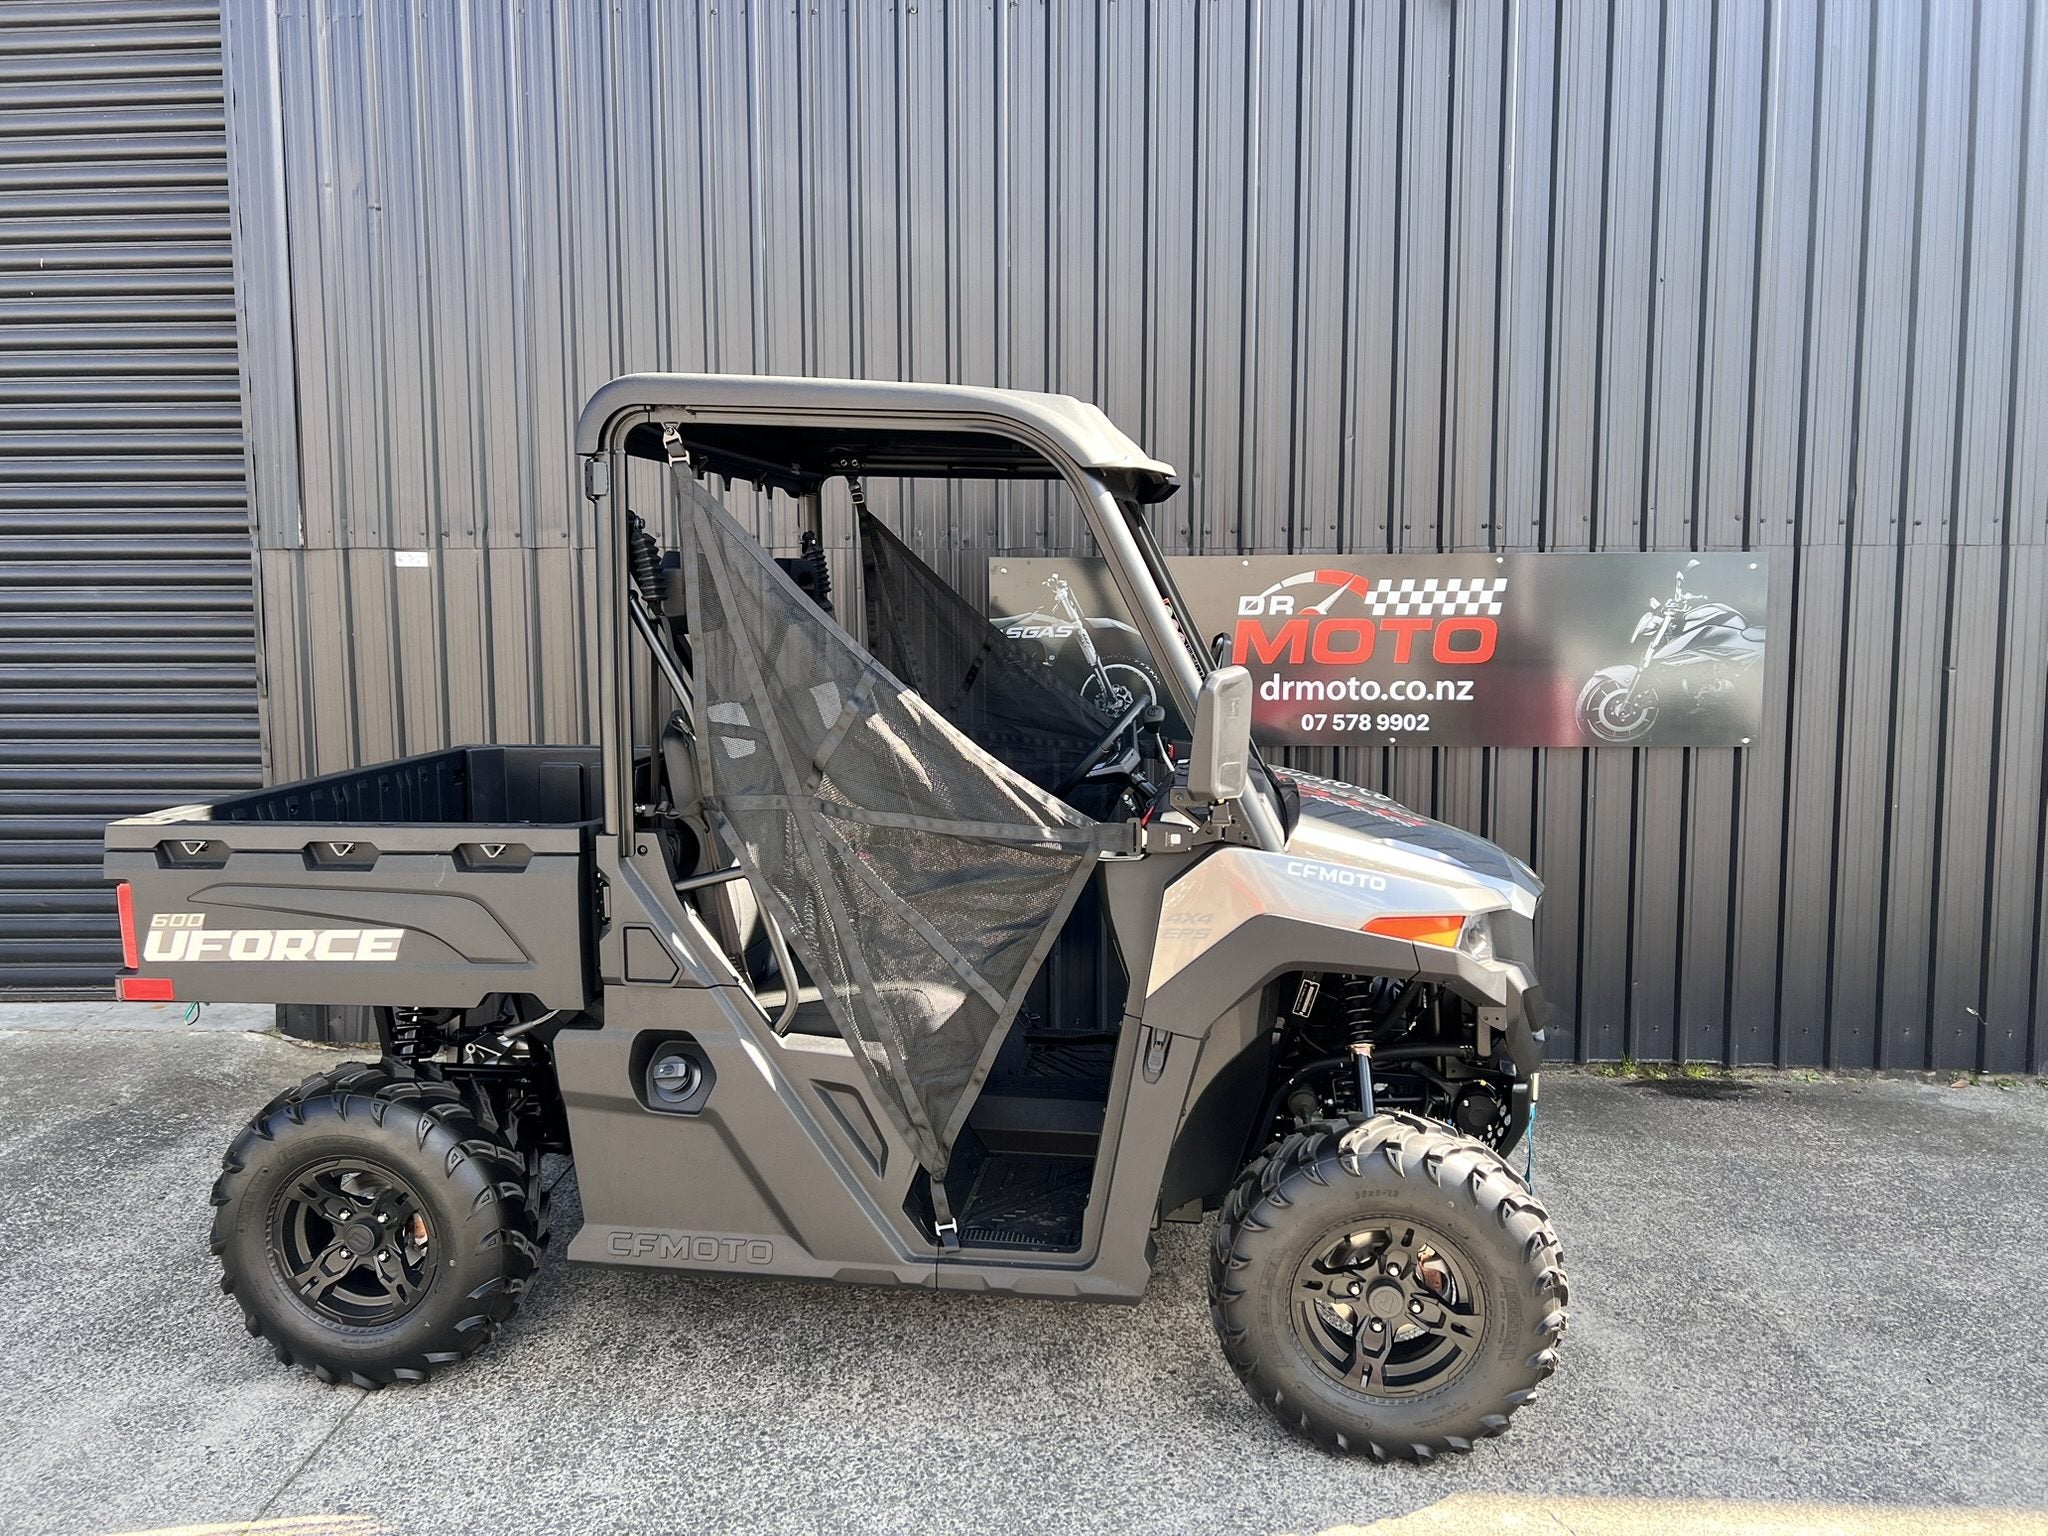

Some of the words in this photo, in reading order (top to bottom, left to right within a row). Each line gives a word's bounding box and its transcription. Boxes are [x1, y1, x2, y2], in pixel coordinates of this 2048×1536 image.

[1238, 595, 1295, 616] DR
[1000, 626, 1073, 638] SGAS
[1232, 617, 1498, 664] MOTO
[1260, 673, 1474, 701] drmoto.co.nz
[1301, 714, 1326, 731] 07
[1332, 714, 1371, 731] 578
[1376, 714, 1430, 731] 9902
[1287, 861, 1386, 892] CFMOTO
[151, 913, 204, 928] 600
[143, 929, 405, 962] UFORCE
[1162, 928, 1212, 939] EPS
[607, 1231, 774, 1266] CFMOTO
